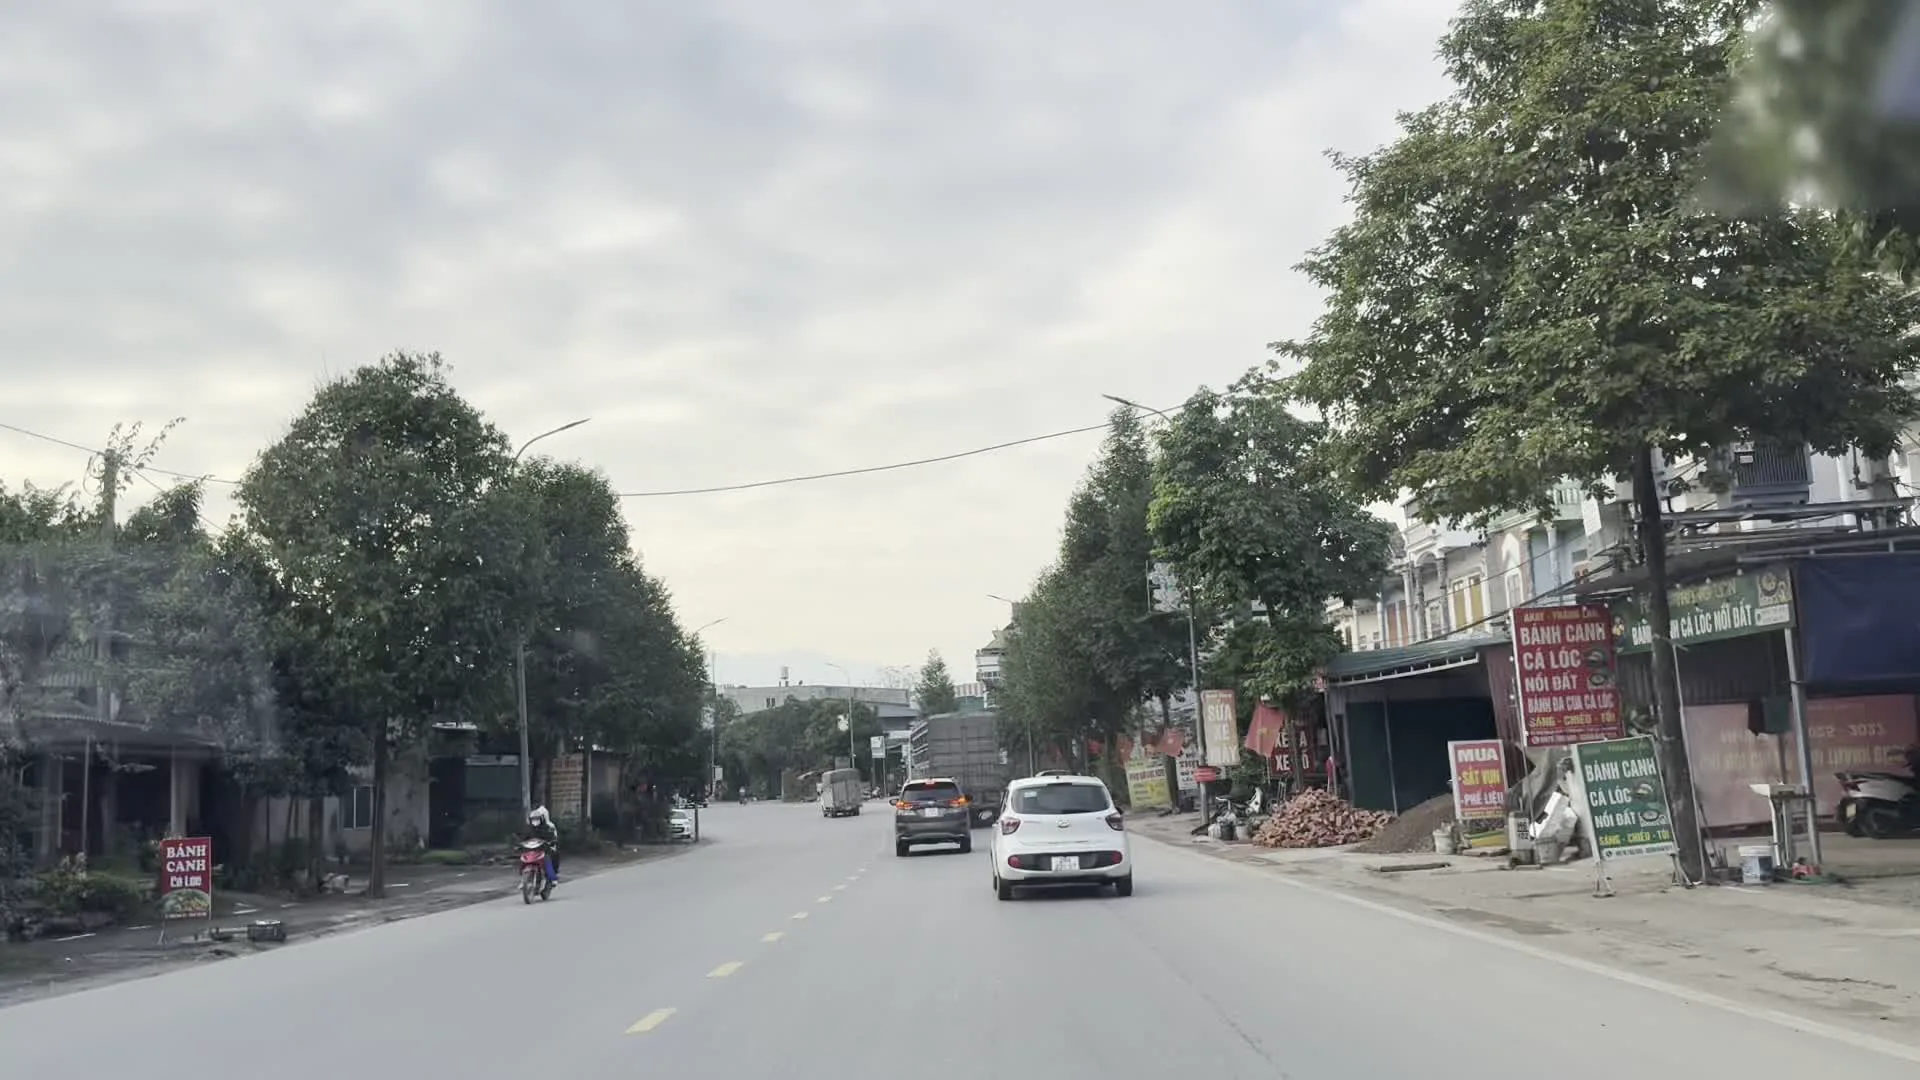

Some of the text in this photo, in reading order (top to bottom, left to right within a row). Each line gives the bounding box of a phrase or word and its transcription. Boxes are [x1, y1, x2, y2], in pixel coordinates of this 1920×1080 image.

[1681, 612, 1694, 638] CÁ
[1520, 623, 1606, 646] BÁNH CANH
[1523, 646, 1582, 670] CÁ LÓC
[1553, 670, 1579, 690] ĐẤT
[1527, 695, 1552, 713] BÁNH
[1584, 691, 1597, 710] CÁ
[1528, 714, 1556, 727] SÁNG
[1214, 723, 1230, 740] XE
[1275, 755, 1291, 771] XE
[1457, 748, 1499, 762] MUA
[1584, 757, 1657, 782] BÁNH CANH
[1590, 785, 1632, 807] CÁ LÓC
[1616, 808, 1636, 826] ĐẤT
[1599, 834, 1621, 845] SÁNG
[167, 843, 206, 858] BÁNH
[167, 860, 206, 873] CANH
